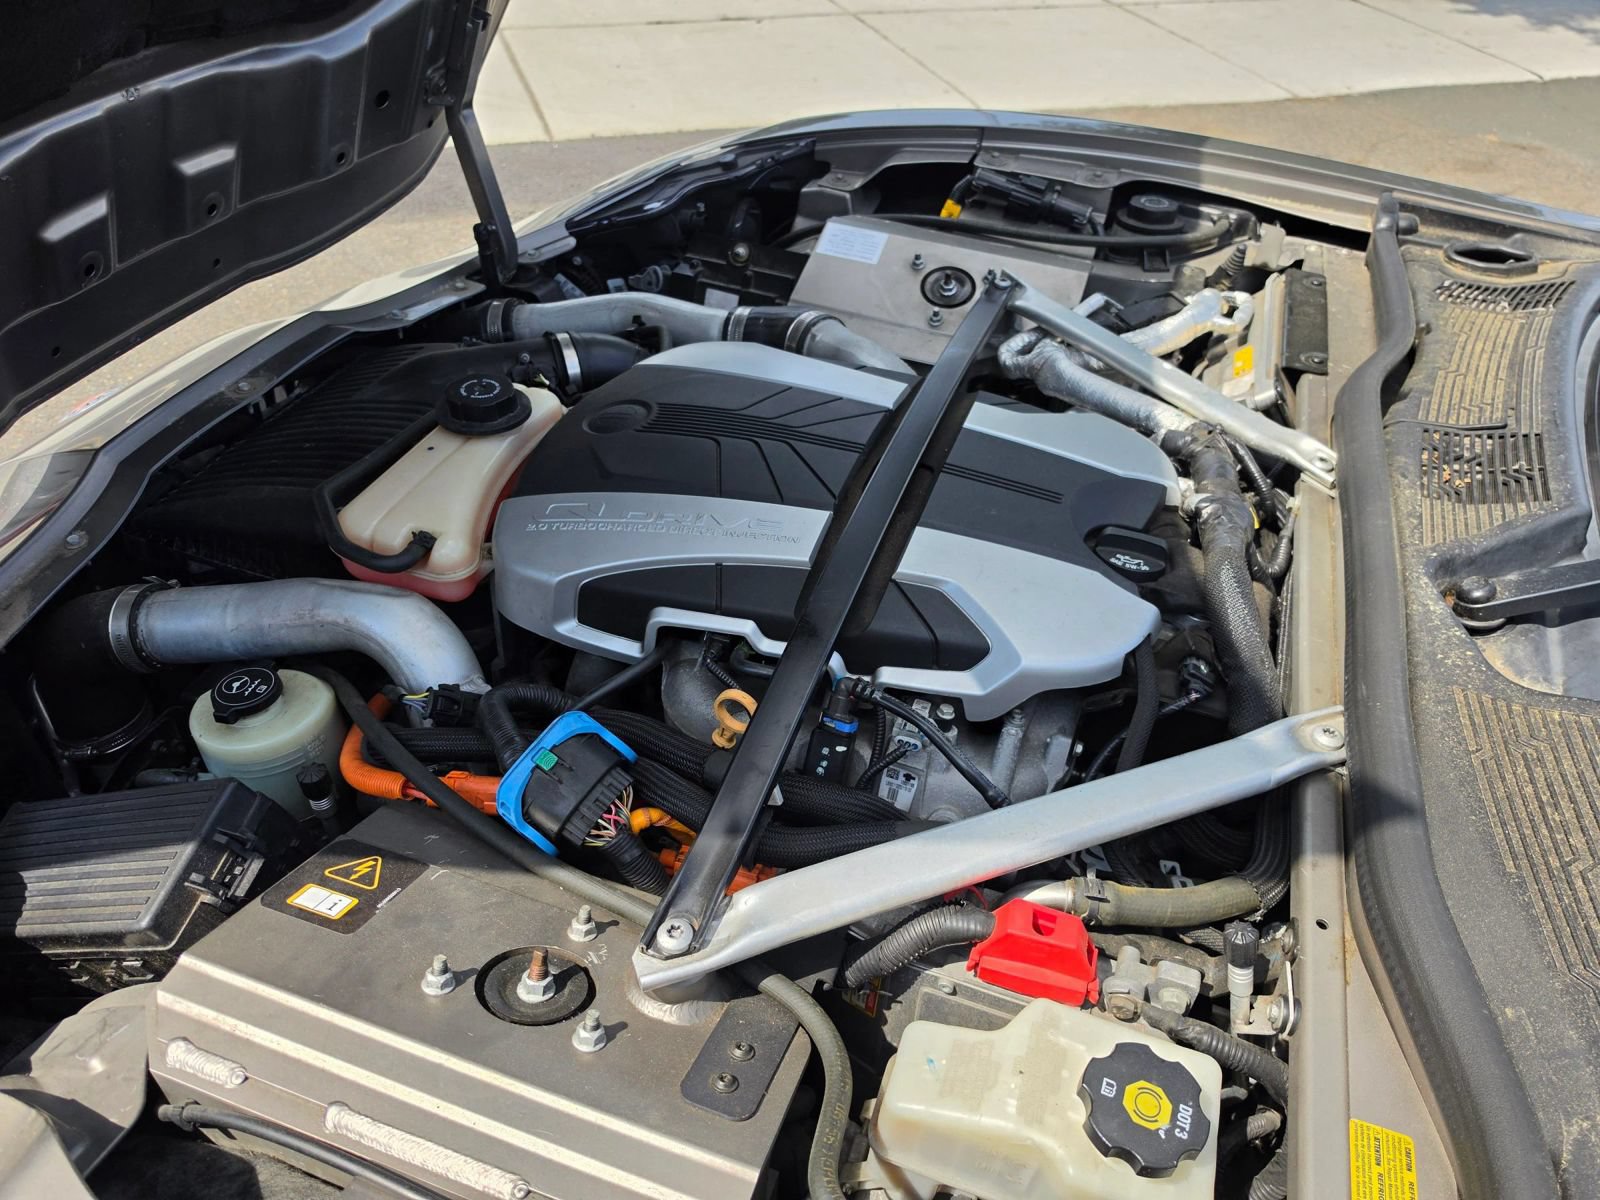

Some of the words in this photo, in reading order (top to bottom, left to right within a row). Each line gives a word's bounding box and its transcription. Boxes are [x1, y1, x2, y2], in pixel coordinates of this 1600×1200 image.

[550, 522, 666, 533] TURBOCHARGED
[668, 525, 716, 536] DIRECT
[720, 529, 801, 544] INJECTION
[1176, 1104, 1192, 1131] DOT
[1174, 1128, 1188, 1140] 3
[1373, 1136, 1381, 1167] ATTENTION
[1404, 1147, 1412, 1172] CAUTION
